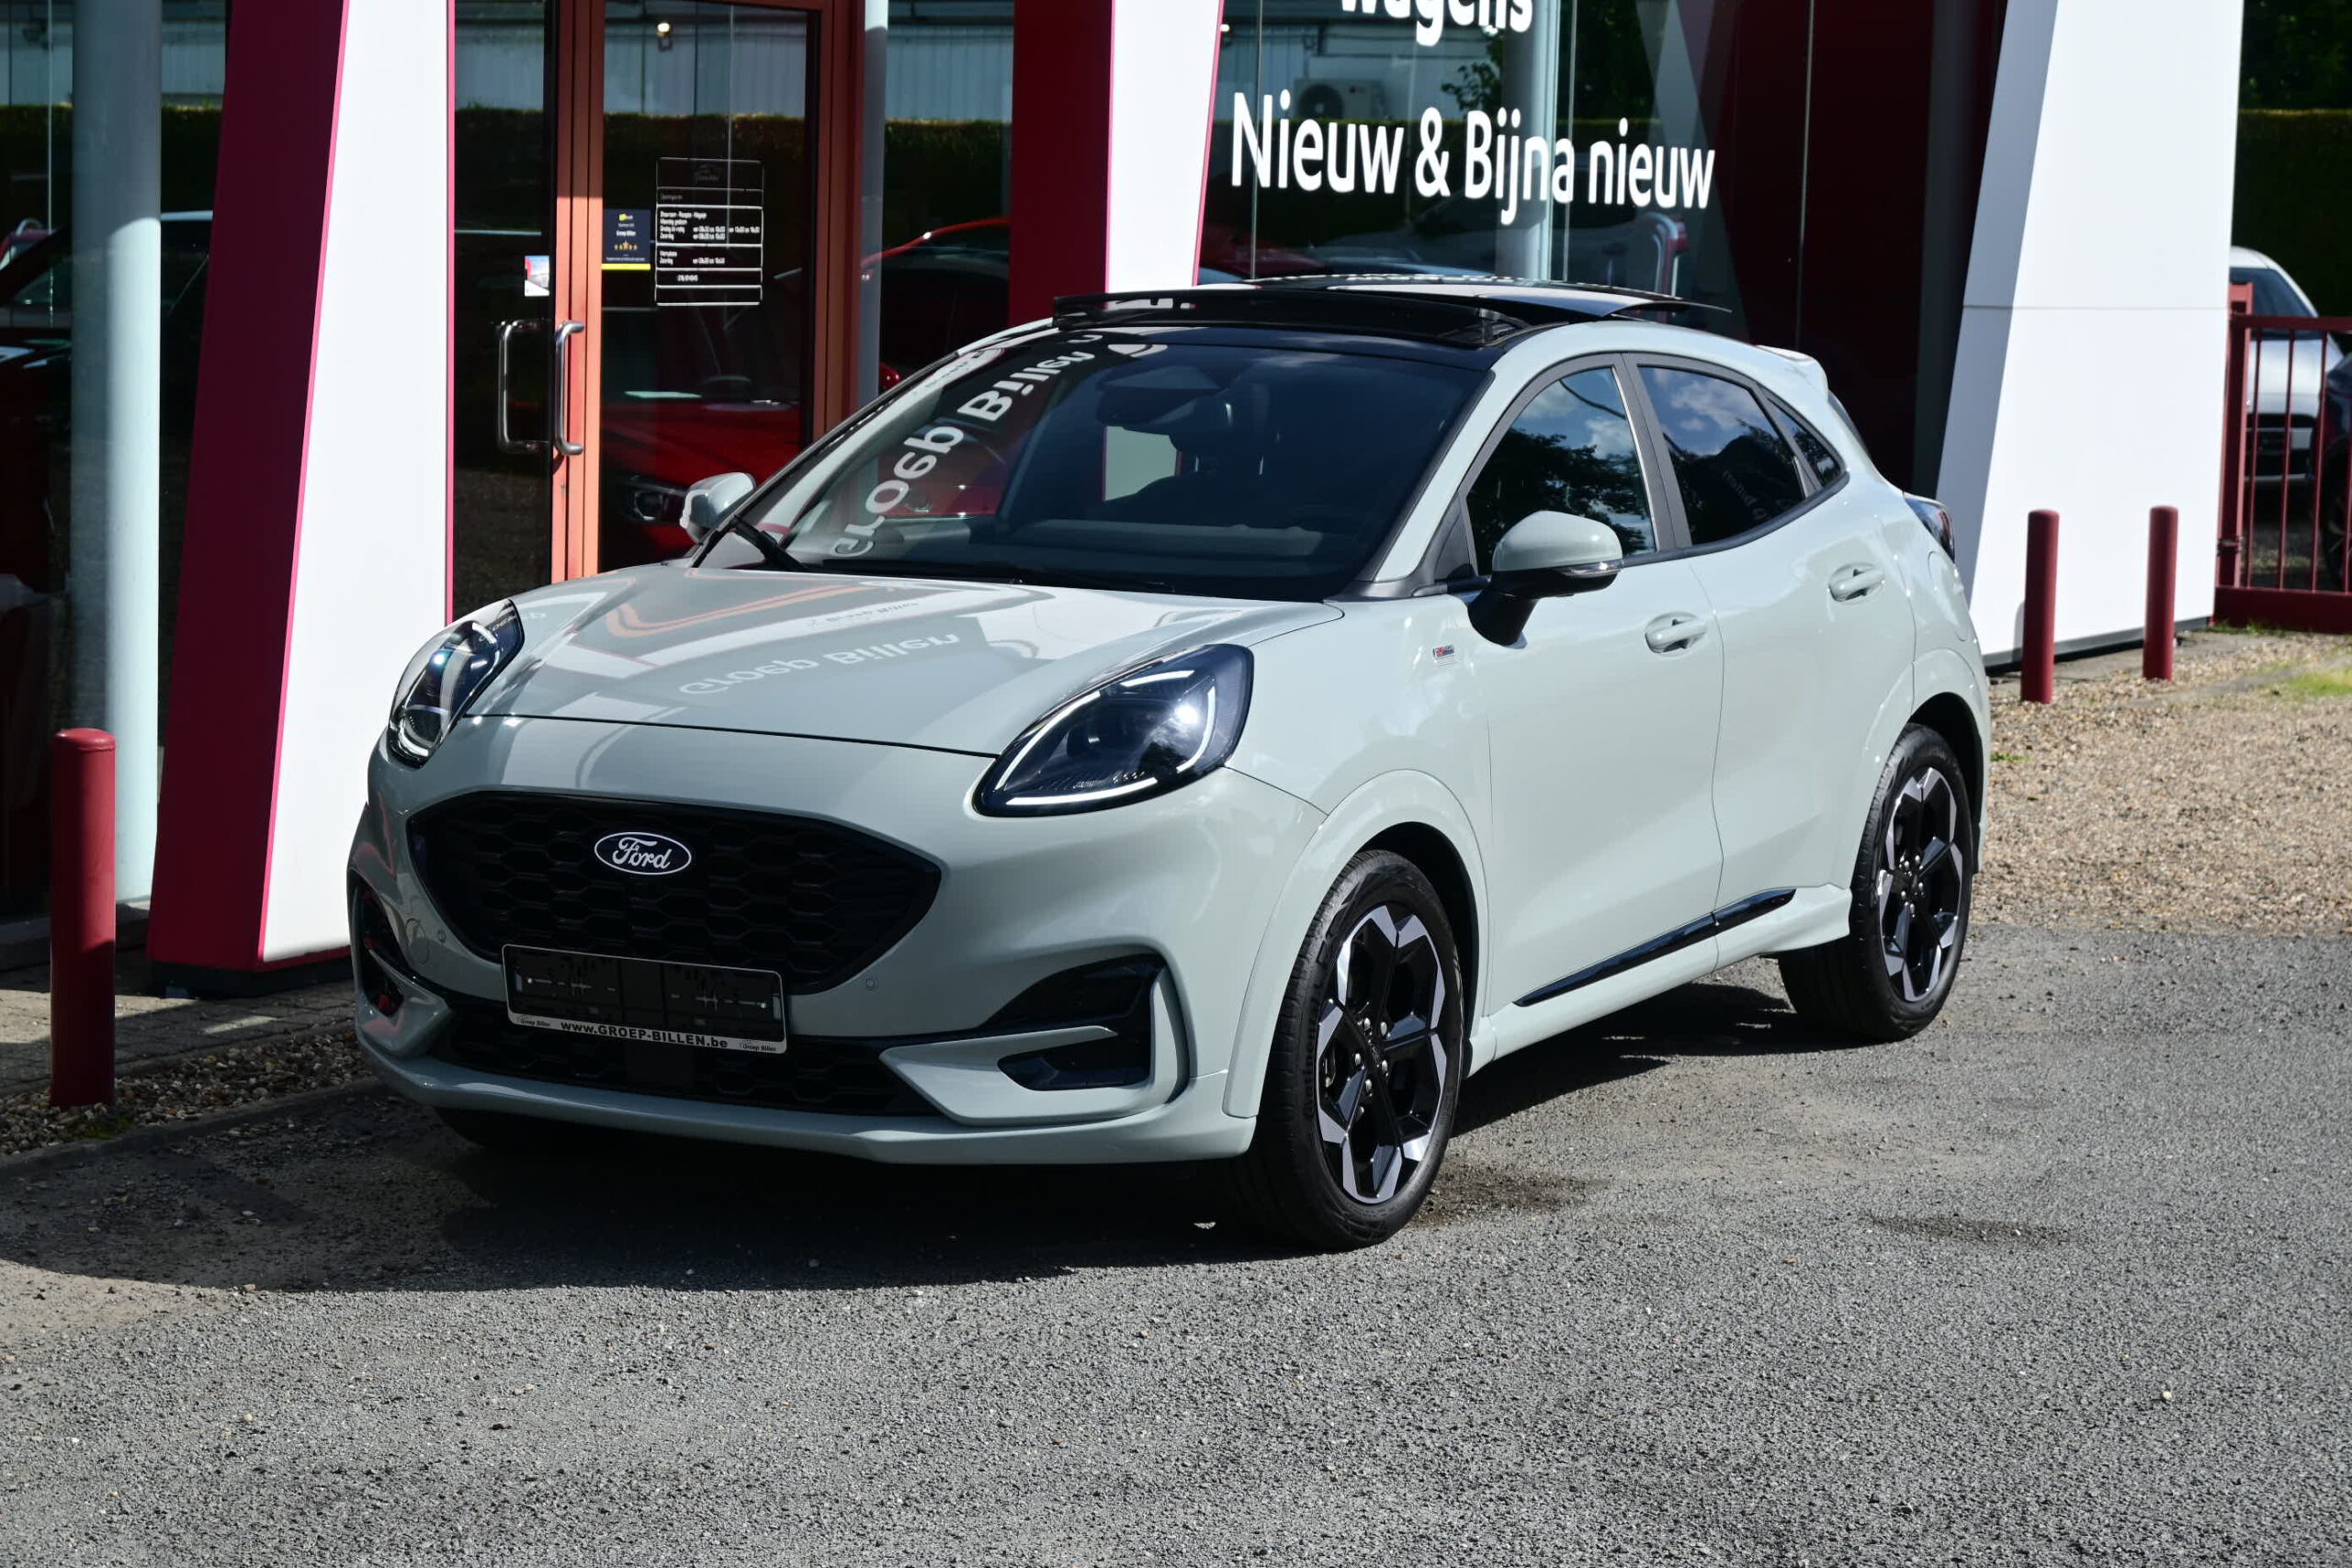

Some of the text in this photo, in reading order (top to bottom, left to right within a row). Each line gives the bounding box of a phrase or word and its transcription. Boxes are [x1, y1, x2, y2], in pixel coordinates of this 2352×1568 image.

[1341, 0, 1533, 47] gns
[1232, 89, 1715, 225] Nieuw & Bijna nieuw
[612, 836, 673, 869] Ford
[560, 1021, 728, 1048] www.GROEP-BILLEN.be
